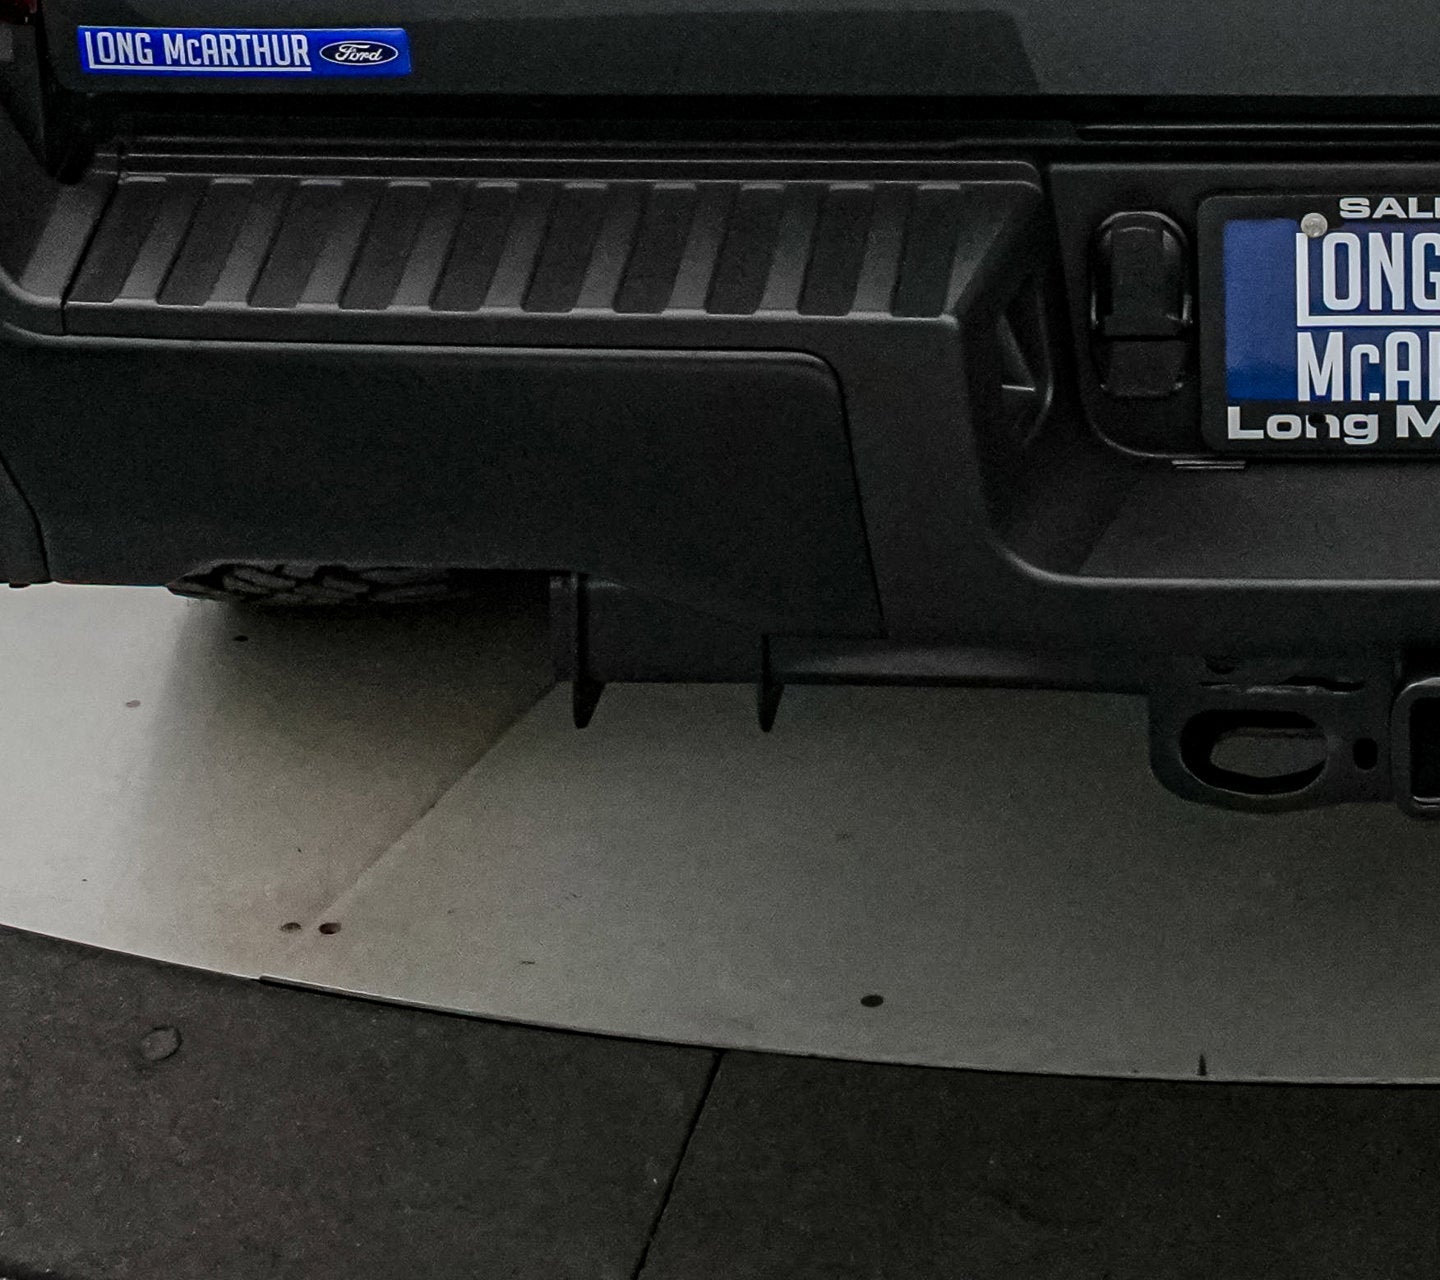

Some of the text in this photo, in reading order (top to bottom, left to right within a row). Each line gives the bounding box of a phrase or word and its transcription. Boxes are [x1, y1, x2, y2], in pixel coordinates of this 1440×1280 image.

[85, 31, 311, 69] LONG McARTHUR
[335, 43, 383, 61] Ford
[1227, 405, 1379, 446] Long
